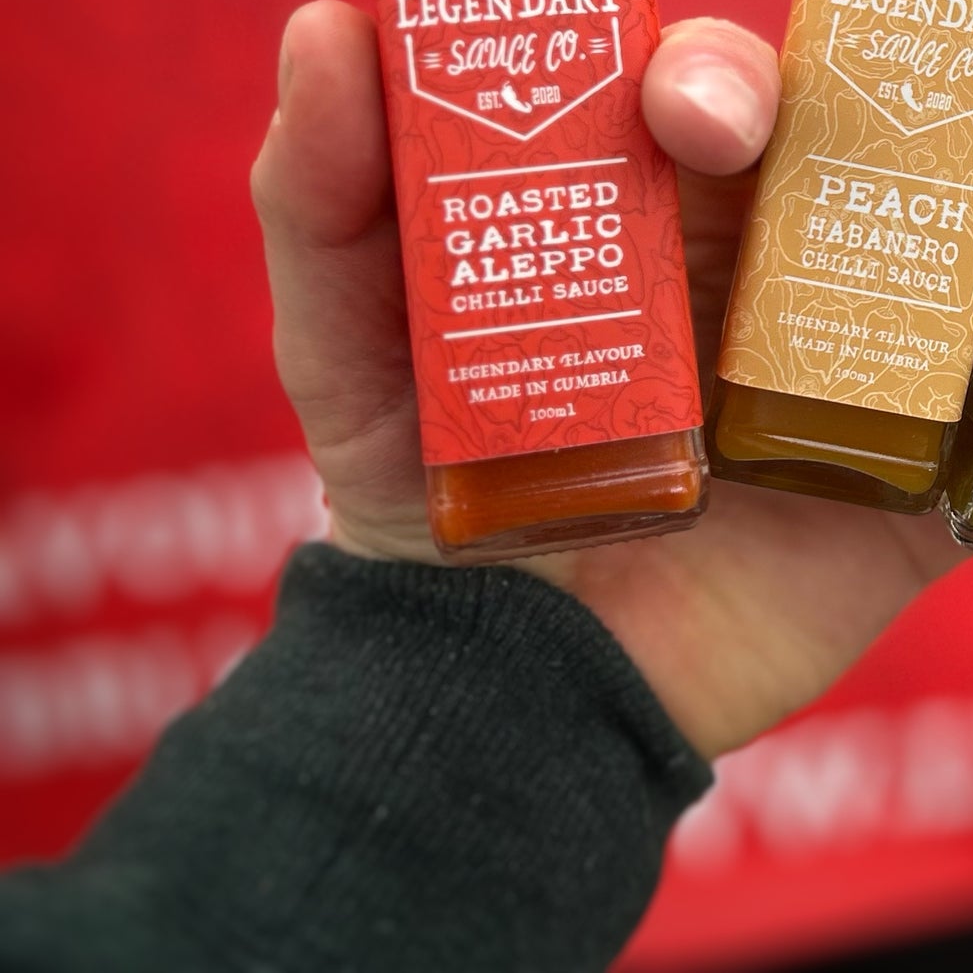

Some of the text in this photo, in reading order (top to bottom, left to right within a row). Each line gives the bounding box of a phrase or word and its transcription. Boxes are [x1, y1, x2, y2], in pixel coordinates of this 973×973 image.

[476, 85, 561, 111] EST. 2020
[878, 80, 953, 112] EST. 2020
[443, 181, 619, 223] ROASTED
[814, 174, 969, 233] PEACH
[446, 213, 622, 256] GARLIC
[806, 215, 959, 267] HABANERO
[451, 243, 624, 287] ALEPPO
[801, 249, 953, 295] CHILLI SAUCE
[451, 275, 629, 313] CHILLI SAUCE
[776, 311, 951, 356] LEGENDARY FLAVOUR
[789, 334, 931, 373] MADE IN CUMBRIA
[447, 344, 645, 383] LEGENDARY FLAVOUR
[468, 369, 631, 405] MADE IN CUMBRIA
[529, 402, 577, 423] 100ml
